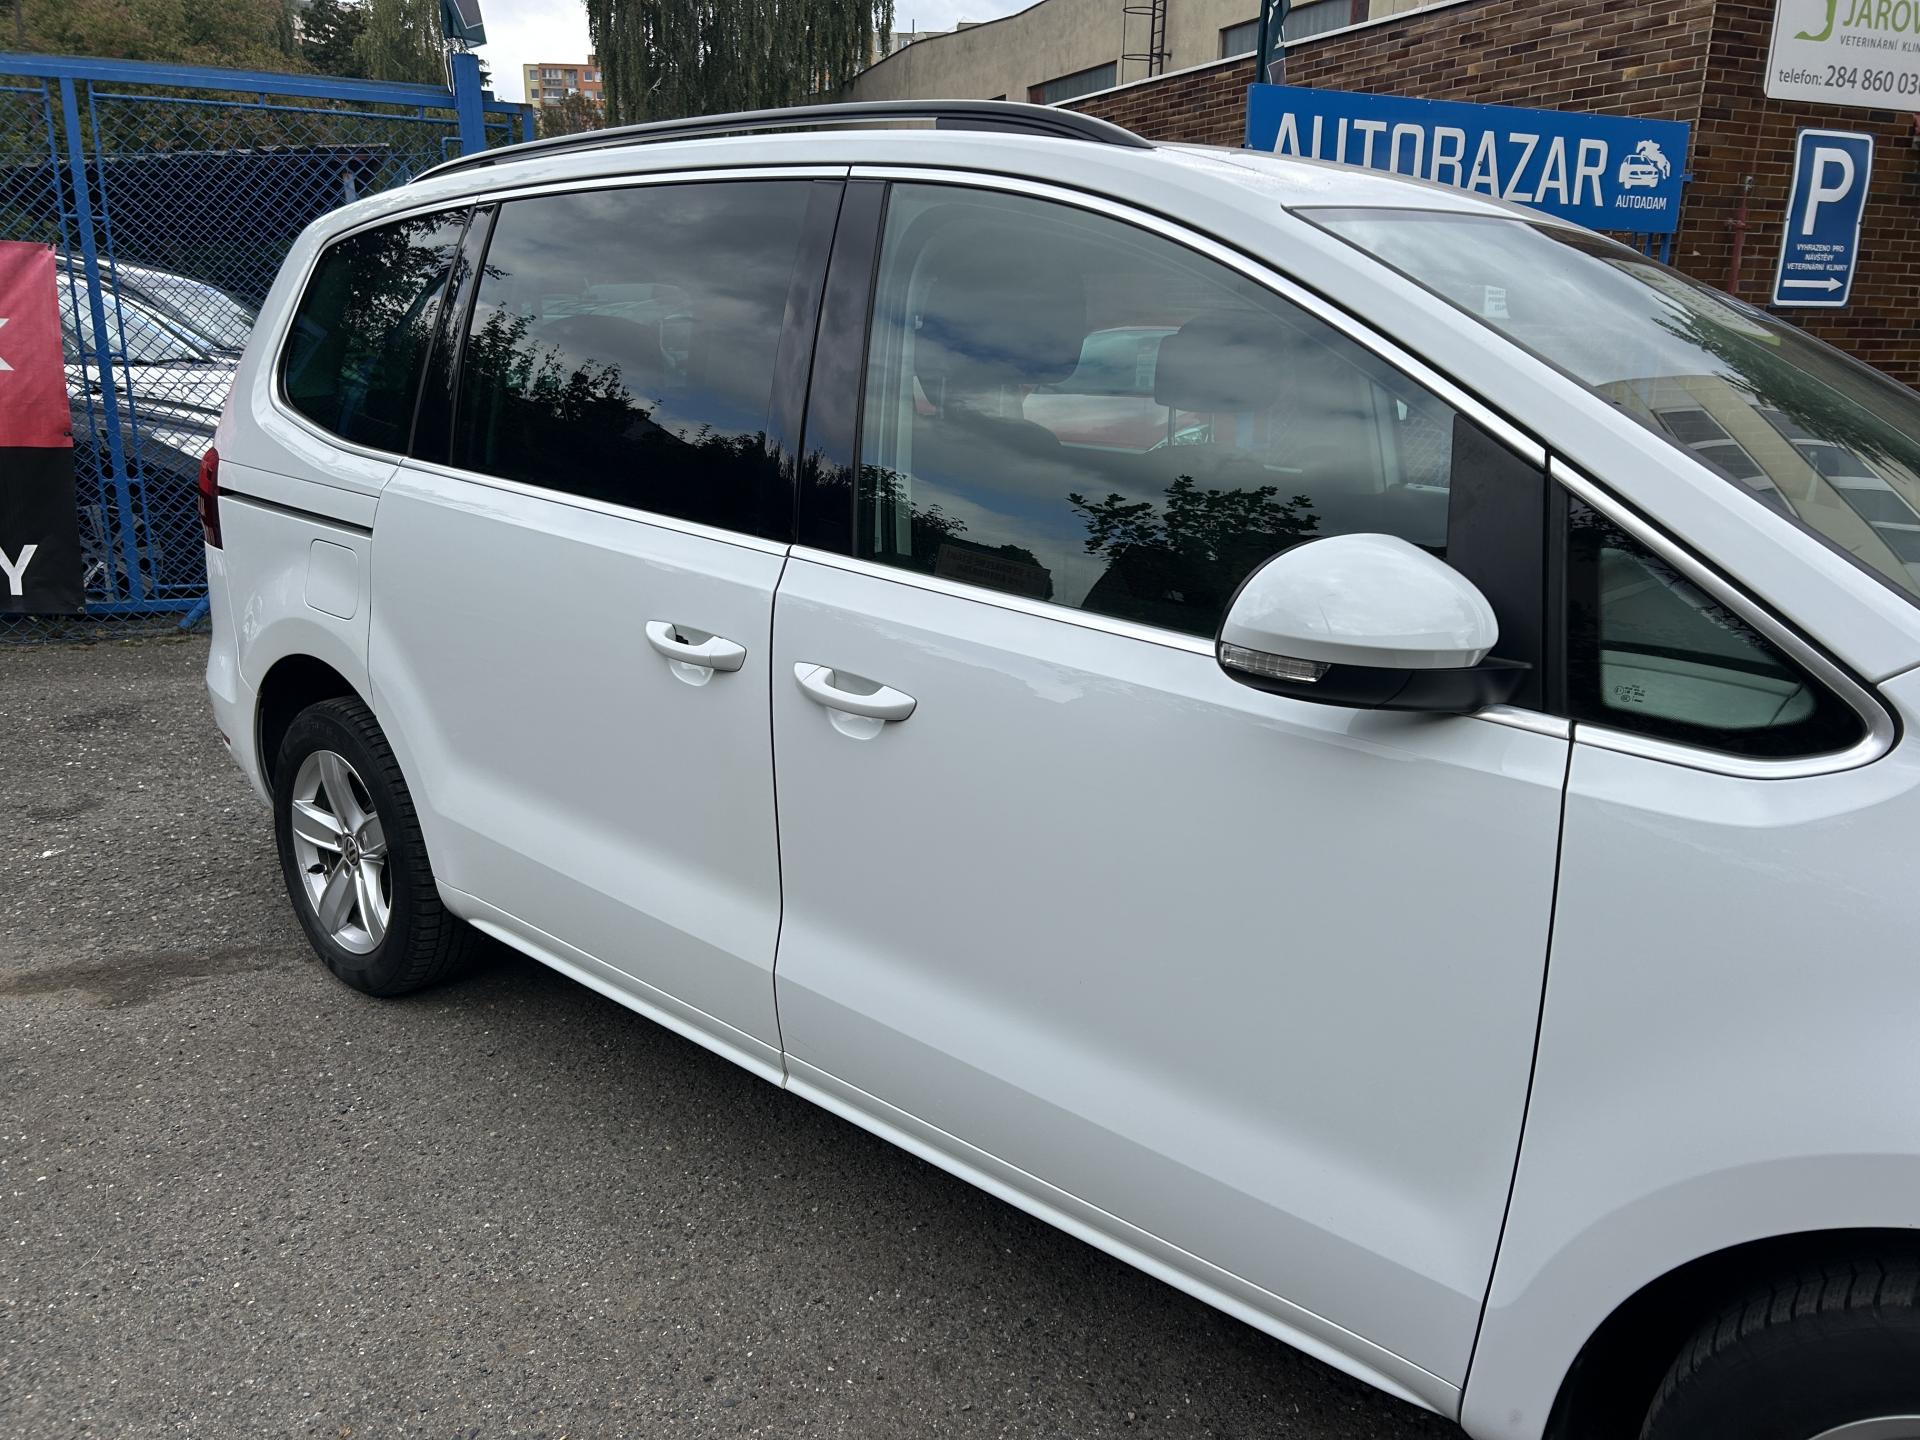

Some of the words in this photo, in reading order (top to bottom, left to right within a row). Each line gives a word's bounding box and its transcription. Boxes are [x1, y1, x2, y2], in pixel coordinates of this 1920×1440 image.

[1840, 35, 1898, 51] VETERINÁRNÍ
[1779, 68, 1822, 86] telefon:
[1824, 65, 1858, 89] 284
[1861, 69, 1894, 92] 860
[1897, 72, 1920, 95] 03
[1273, 112, 1609, 207] AUTOBAZAR
[1802, 147, 1855, 236] P
[1616, 195, 1667, 210] AUTOADAM
[1796, 243, 1831, 252] VYHRAZENO
[1833, 244, 1845, 253] PRO
[1805, 252, 1835, 262] NÁVŠTĚVY
[1787, 262, 1825, 271] VETERINÁRNÍ
[1826, 264, 1849, 272] KLINIKY
